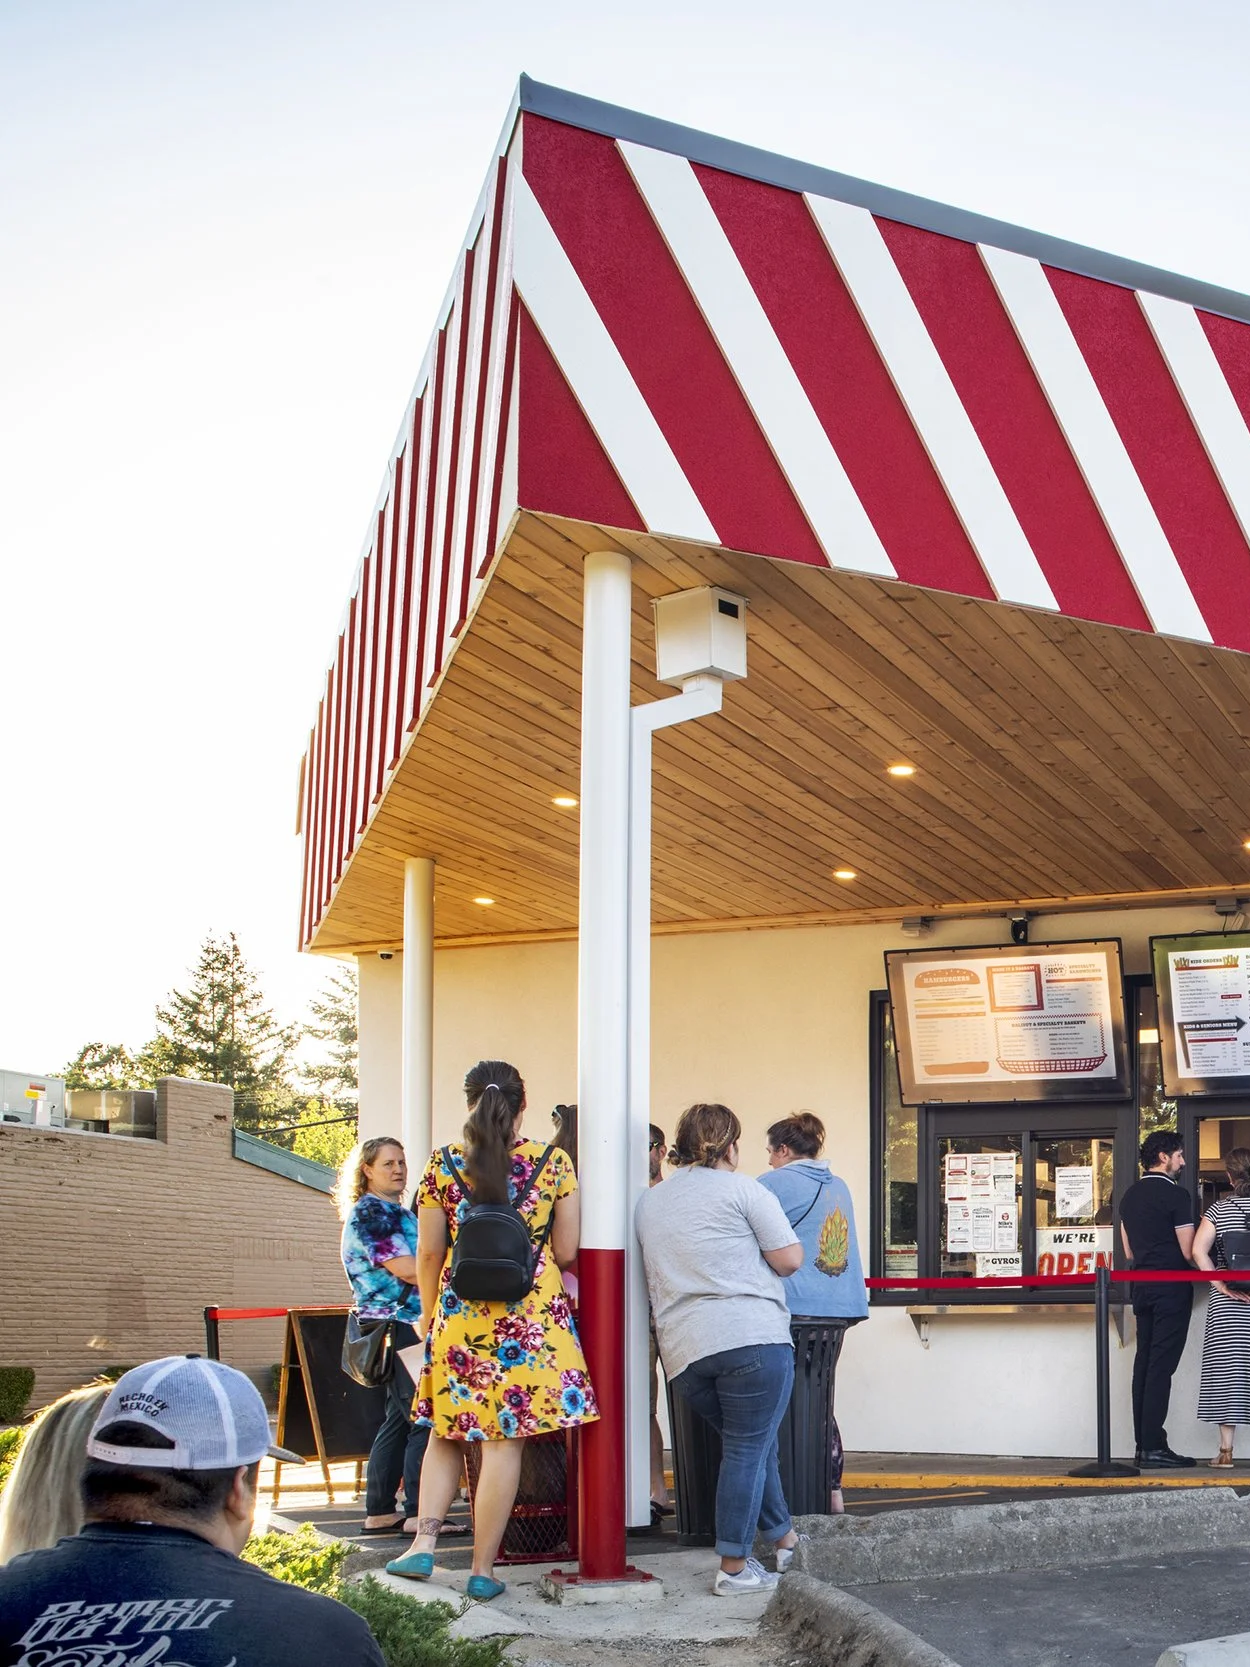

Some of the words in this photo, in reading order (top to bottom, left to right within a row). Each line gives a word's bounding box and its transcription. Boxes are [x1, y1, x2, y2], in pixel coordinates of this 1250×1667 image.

[923, 975, 970, 984] HAMBURGERS
[1053, 1232, 1096, 1244] WE'RE
[991, 1257, 1020, 1265] GYROS
[1038, 1251, 1112, 1277] OPEN
[119, 1392, 154, 1404] HECHO
[154, 1399, 169, 1411] EN
[120, 1402, 160, 1417] MEXICO
